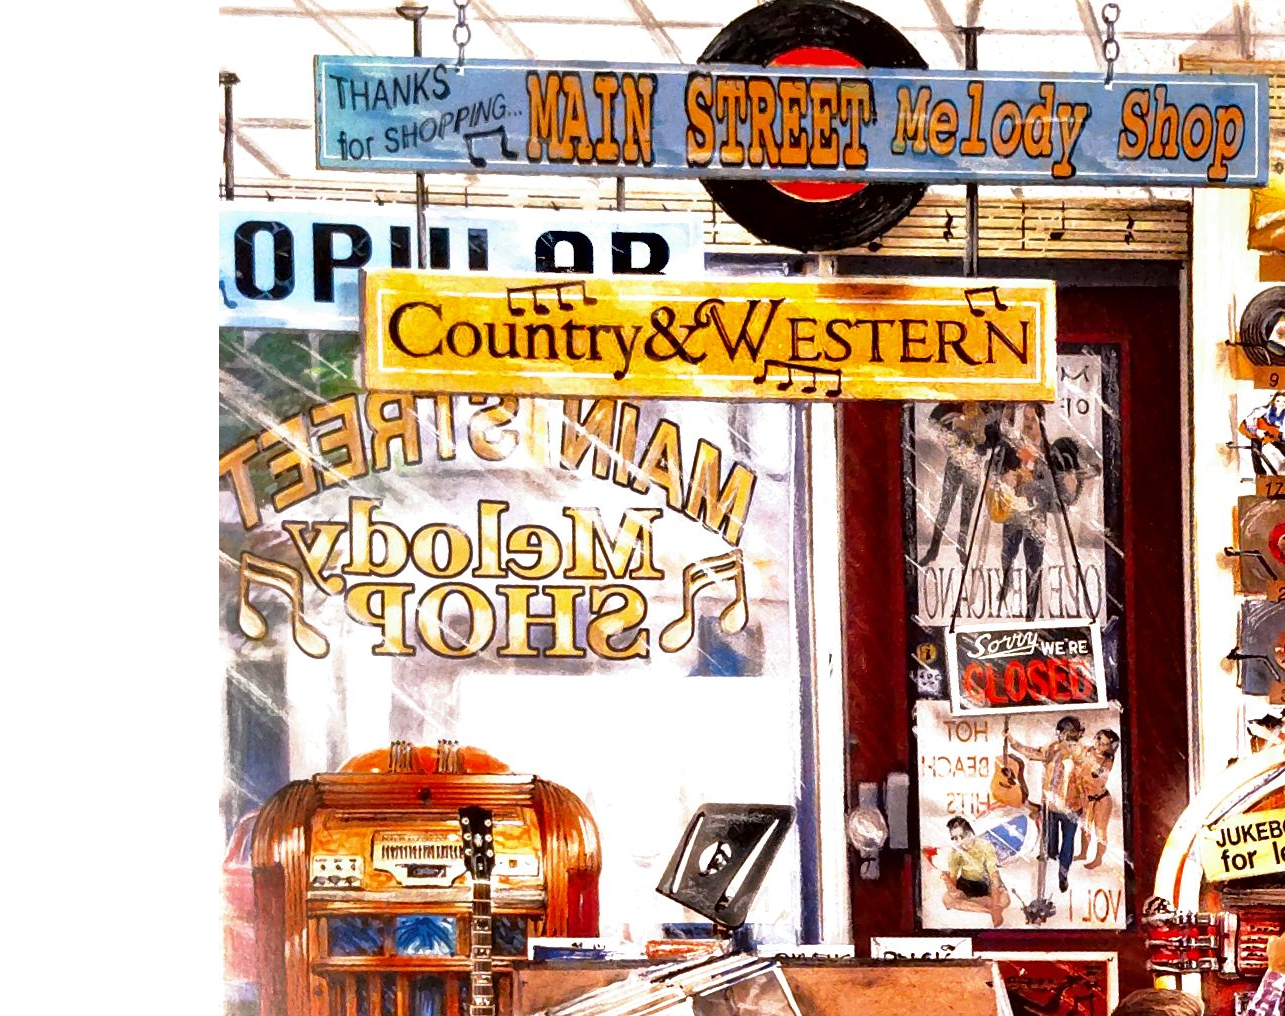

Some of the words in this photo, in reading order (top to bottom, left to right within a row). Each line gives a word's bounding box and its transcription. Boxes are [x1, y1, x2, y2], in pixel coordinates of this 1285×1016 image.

[330, 64, 450, 110] THANKS
[525, 69, 658, 168] MAIN
[684, 70, 878, 169] STREET
[891, 80, 1091, 179] Melody
[1118, 83, 1246, 182] Shop
[338, 130, 372, 161] for
[1268, 372, 1280, 388] 9
[966, 630, 1039, 660] Sorry
[1041, 637, 1089, 656] WE'RE
[961, 658, 1094, 705] CLOSED
[1221, 849, 1258, 873] for
